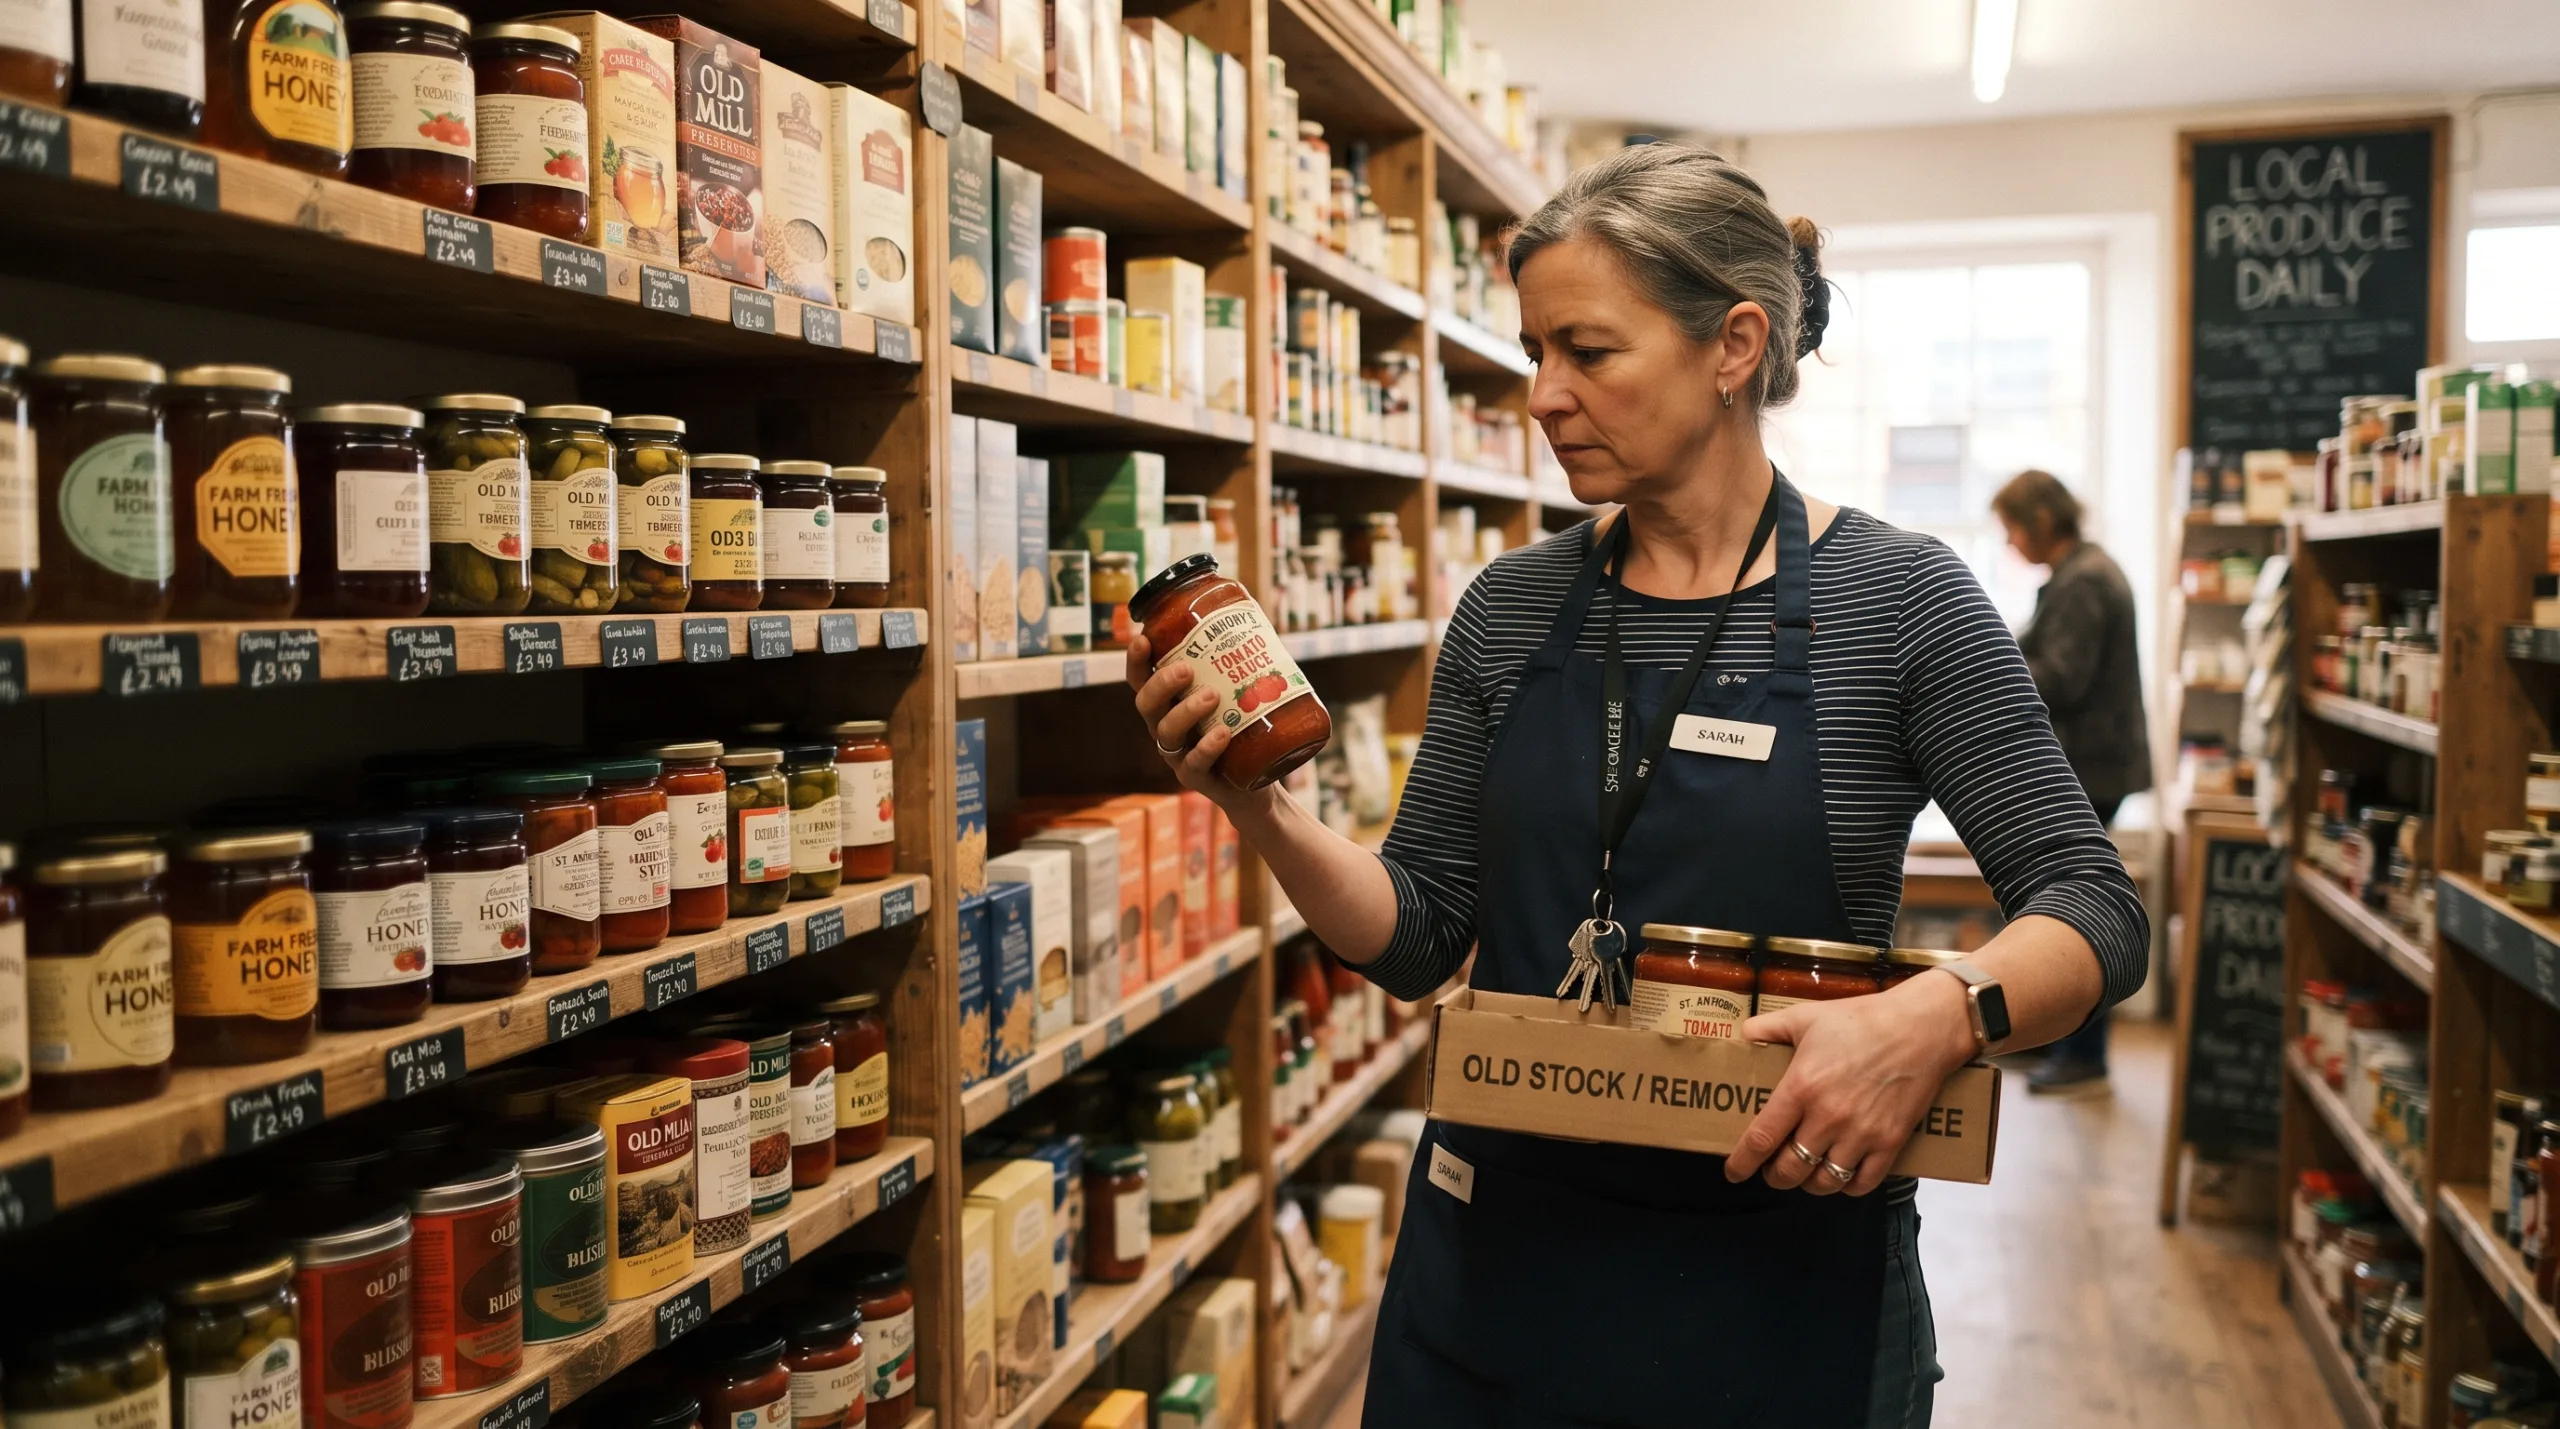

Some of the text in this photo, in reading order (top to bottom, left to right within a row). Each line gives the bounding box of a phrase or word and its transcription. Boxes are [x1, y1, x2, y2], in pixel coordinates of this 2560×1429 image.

[261, 49, 308, 68] FARM
[700, 65, 744, 102] OLD
[695, 92, 752, 138] MILL
[2228, 144, 2389, 202] LOCAL
[2206, 196, 2413, 259] PRODUCE
[437, 240, 476, 266] £2.49
[2235, 254, 2374, 311] DAILY
[97, 476, 150, 497] FARM
[209, 486, 258, 503] FARM
[478, 484, 506, 497] OLD
[568, 491, 594, 504] OLD
[646, 495, 670, 506] OLD
[1210, 634, 1267, 675] TOMATO
[399, 659, 443, 681] £3.49
[1227, 651, 1273, 684] SAUCE
[1697, 729, 1745, 745] SARAH
[479, 897, 528, 921] HONE
[227, 937, 285, 957] FARM
[97, 969, 150, 987] FARM
[239, 951, 318, 985] HONEY
[105, 981, 174, 1016] HONE
[1679, 998, 1693, 1009] ST.
[1683, 1019, 1732, 1038] TOMATO
[405, 1061, 446, 1094] £3.49
[1462, 1053, 1521, 1088] OLD
[1528, 1061, 1627, 1101] STOCK
[1632, 1073, 1644, 1102] /
[1912, 1107, 1964, 1139] EE
[252, 1105, 304, 1142] £2.49
[628, 1130, 661, 1152] OLD
[1437, 1162, 1461, 1185] SARAH
[569, 1183, 594, 1201] OLD
[491, 1220, 515, 1243] OLD
[366, 1272, 397, 1297] OLD
[231, 1384, 272, 1405] FARM
